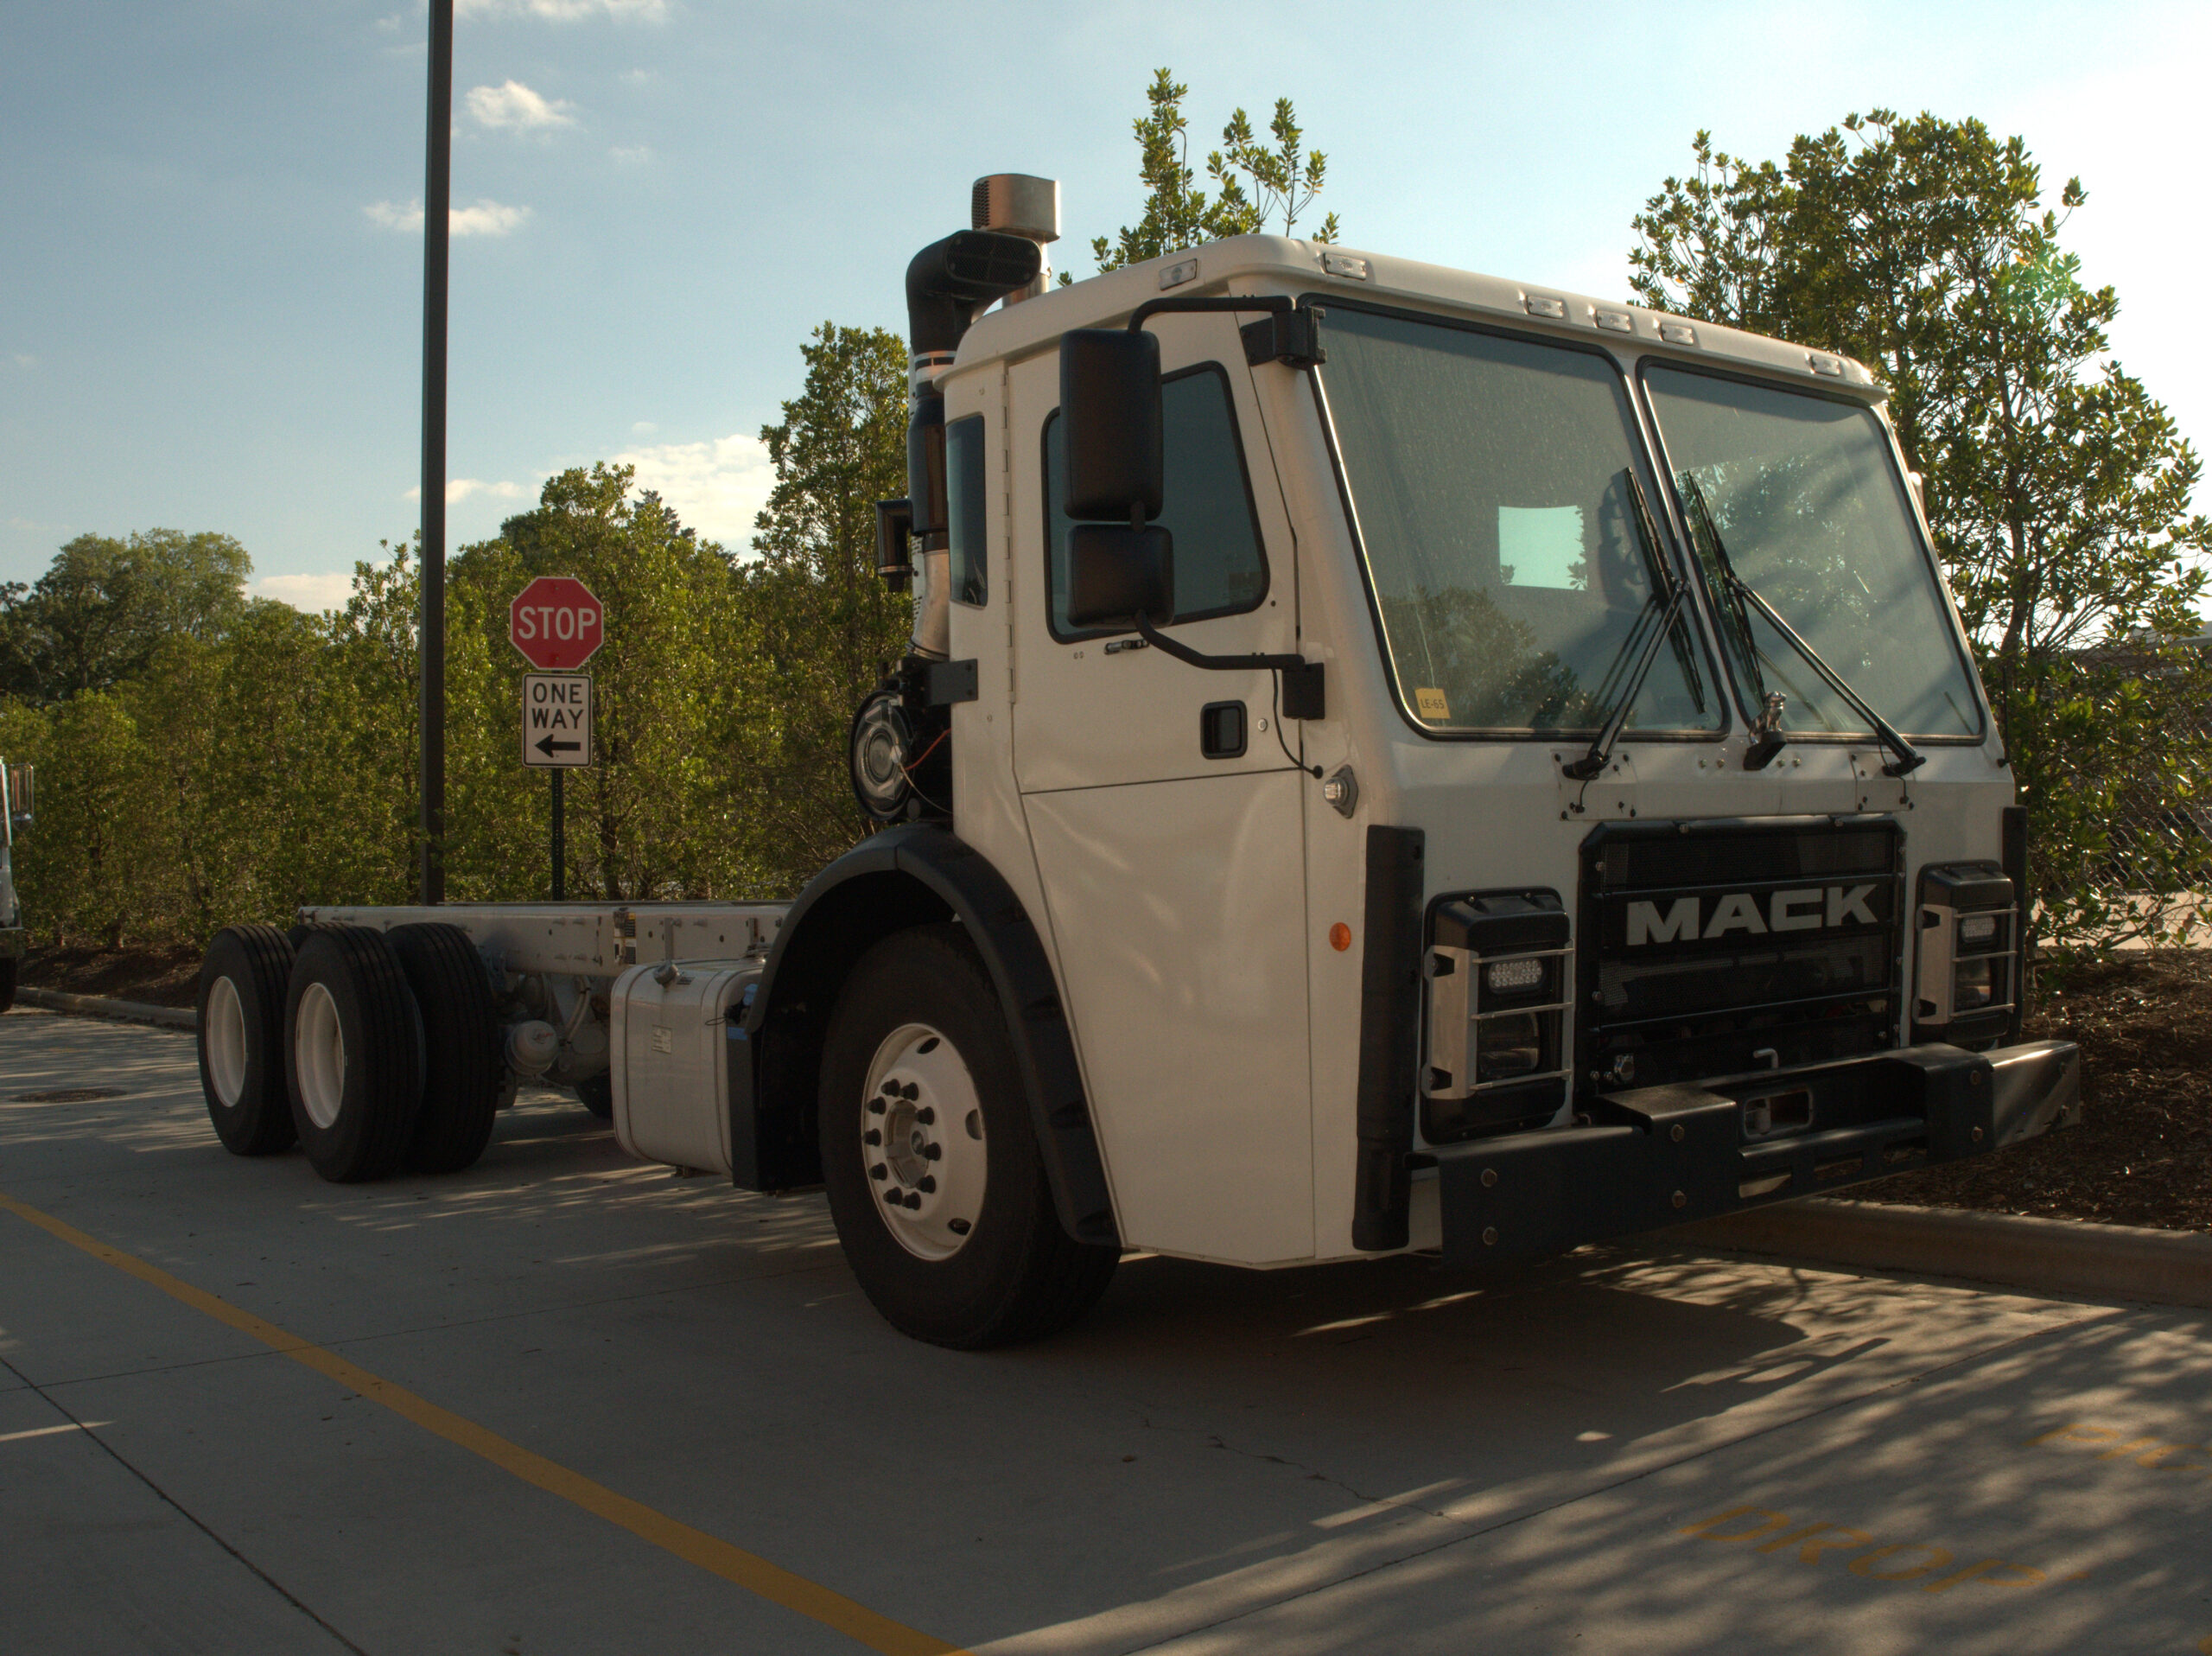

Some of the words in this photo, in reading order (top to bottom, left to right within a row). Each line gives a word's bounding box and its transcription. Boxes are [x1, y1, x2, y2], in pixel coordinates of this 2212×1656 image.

[518, 606, 596, 640] STOP
[532, 683, 582, 704] ONE
[531, 708, 584, 729] WAY
[1626, 883, 1878, 946] MACK
[2022, 1424, 2212, 1477] PIC
